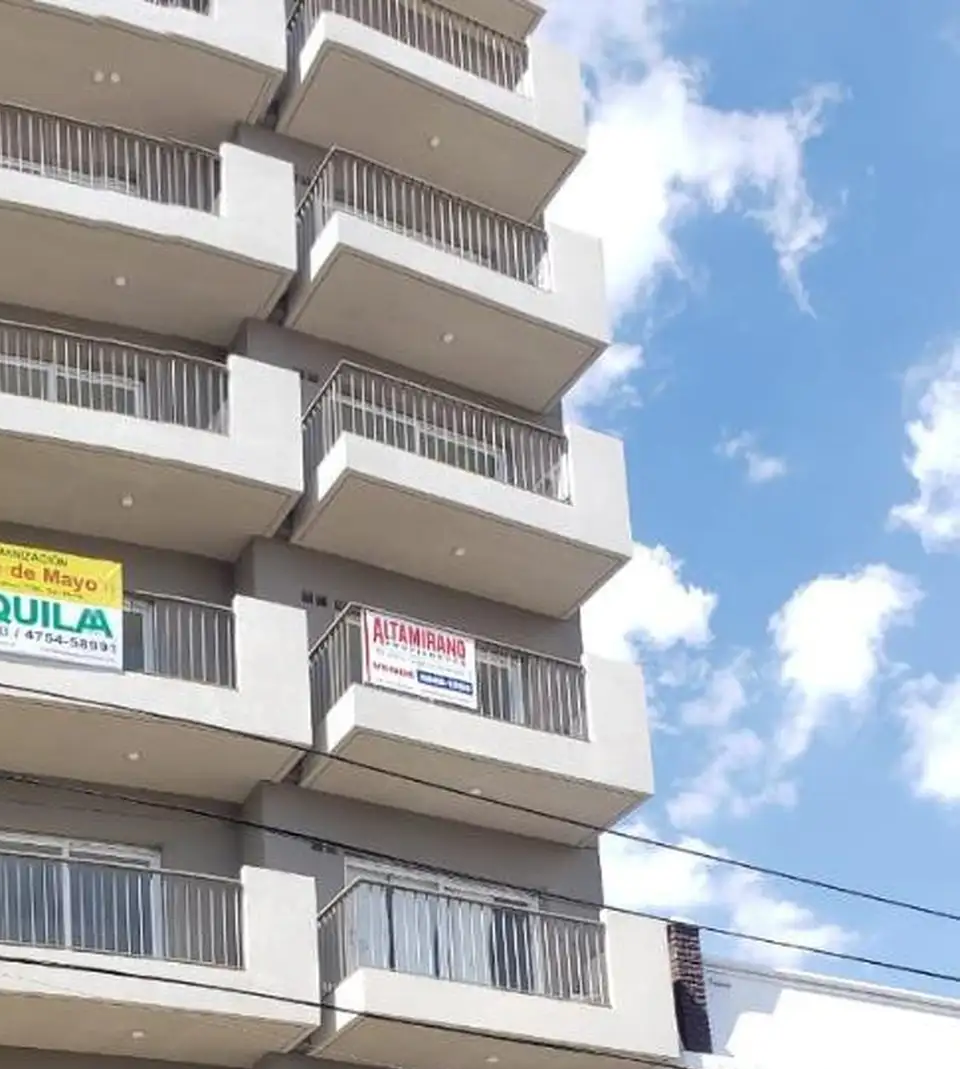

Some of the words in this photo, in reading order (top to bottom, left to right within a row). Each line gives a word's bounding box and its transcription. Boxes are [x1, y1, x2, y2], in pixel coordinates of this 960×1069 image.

[10, 562, 36, 582] de
[43, 568, 98, 593] Mayo
[373, 616, 466, 659] ALTAMIRANO
